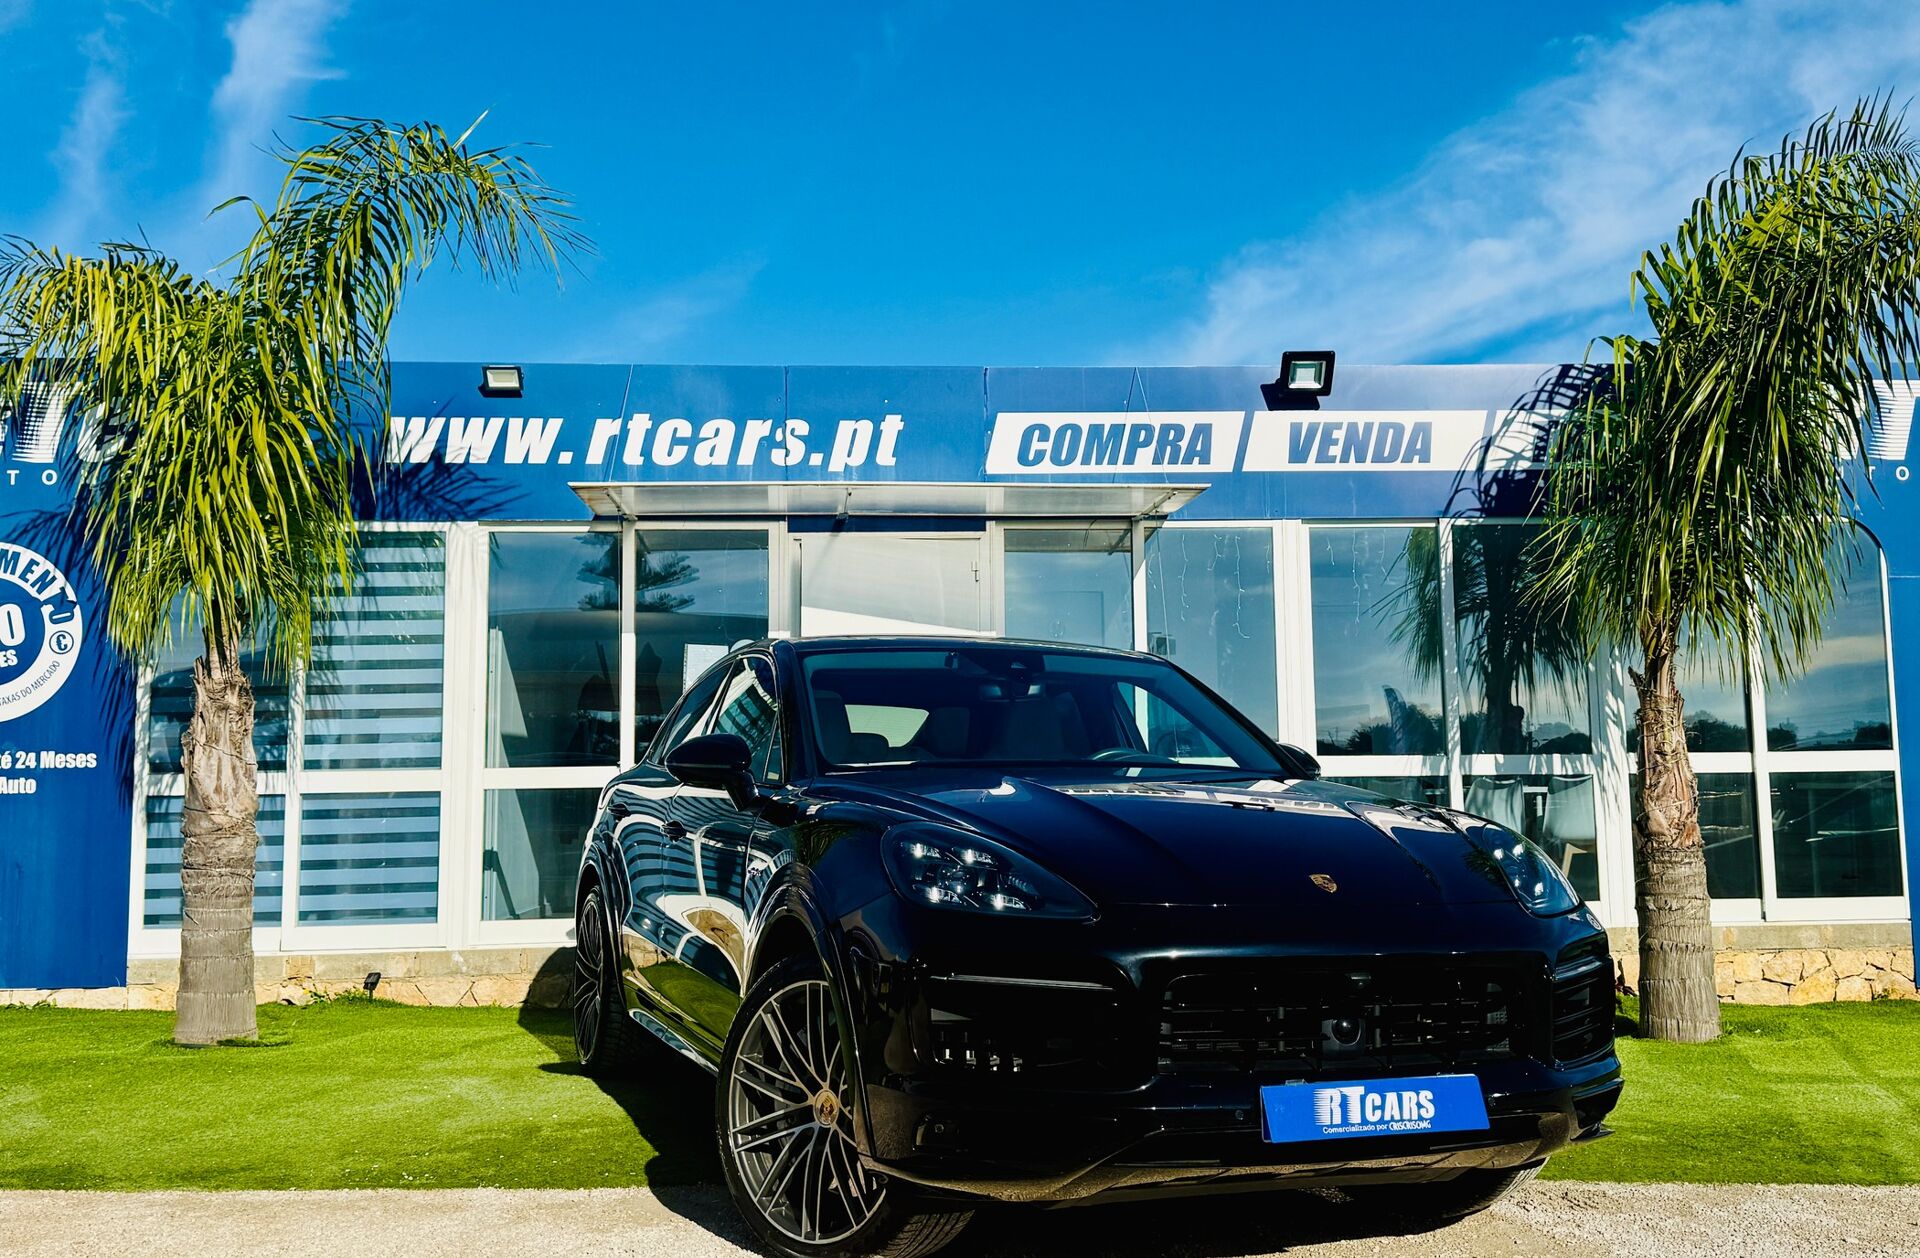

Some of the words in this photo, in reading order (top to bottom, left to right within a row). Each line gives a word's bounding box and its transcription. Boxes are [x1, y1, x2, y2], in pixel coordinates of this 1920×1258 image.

[385, 414, 904, 472] www.rtcars.pt
[1017, 423, 1213, 467] COMPRA
[1288, 421, 1432, 464] VENDA
[20, 687, 32, 698] DO
[31, 660, 61, 691] MERCADO
[15, 751, 37, 769] 24
[40, 751, 97, 769] Meses
[0, 777, 37, 794] Auto
[1323, 1124, 1375, 1134] Comercializado
[1376, 1124, 1388, 1132] por
